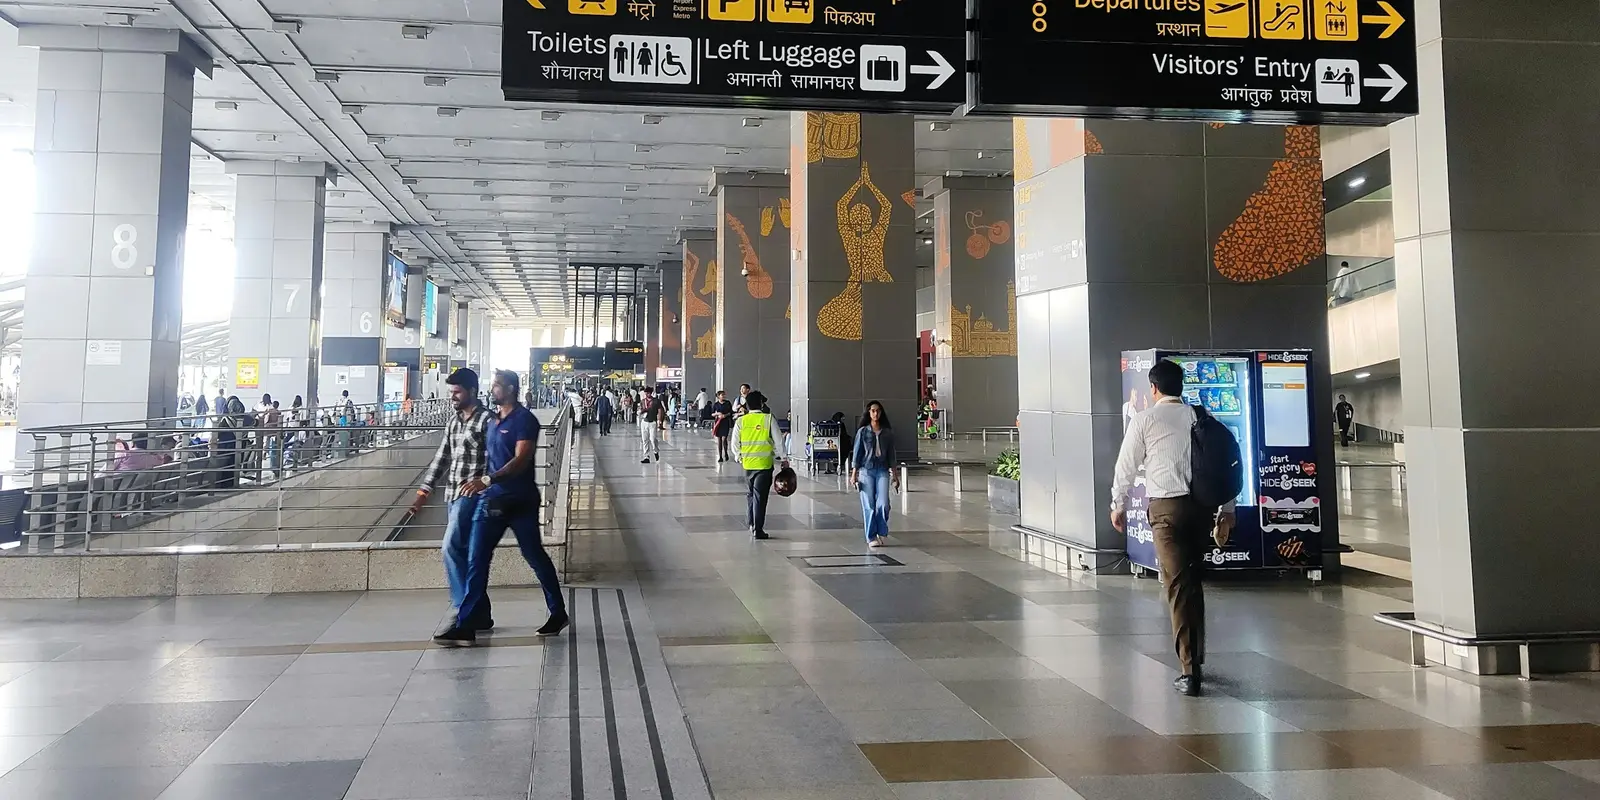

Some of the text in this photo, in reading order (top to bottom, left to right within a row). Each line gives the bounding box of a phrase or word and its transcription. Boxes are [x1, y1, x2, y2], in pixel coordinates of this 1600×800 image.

[824, 6, 876, 26] पिकअप
[1156, 22, 1201, 37] प्रस्थान
[527, 30, 607, 54] Toilets
[705, 38, 856, 68] Left Luggage
[541, 61, 604, 82] शौचालय
[1255, 56, 1312, 82] Entry
[726, 70, 856, 91] अमानती सामानघर
[1220, 83, 1313, 107] आगंतुक प्रवेश
[111, 224, 138, 269] 8
[283, 284, 301, 313] 7
[360, 311, 373, 333] 6
[404, 327, 414, 345] 5
[435, 340, 443, 353] 4
[455, 345, 463, 358] 3
[470, 351, 478, 362] 2
[1268, 351, 1308, 363] HIDE&SEEK
[1270, 455, 1289, 465] Start
[1259, 463, 1301, 477] your story
[1259, 474, 1316, 491] HIDE&SEEK
[1203, 548, 1251, 565] E&SEEK
